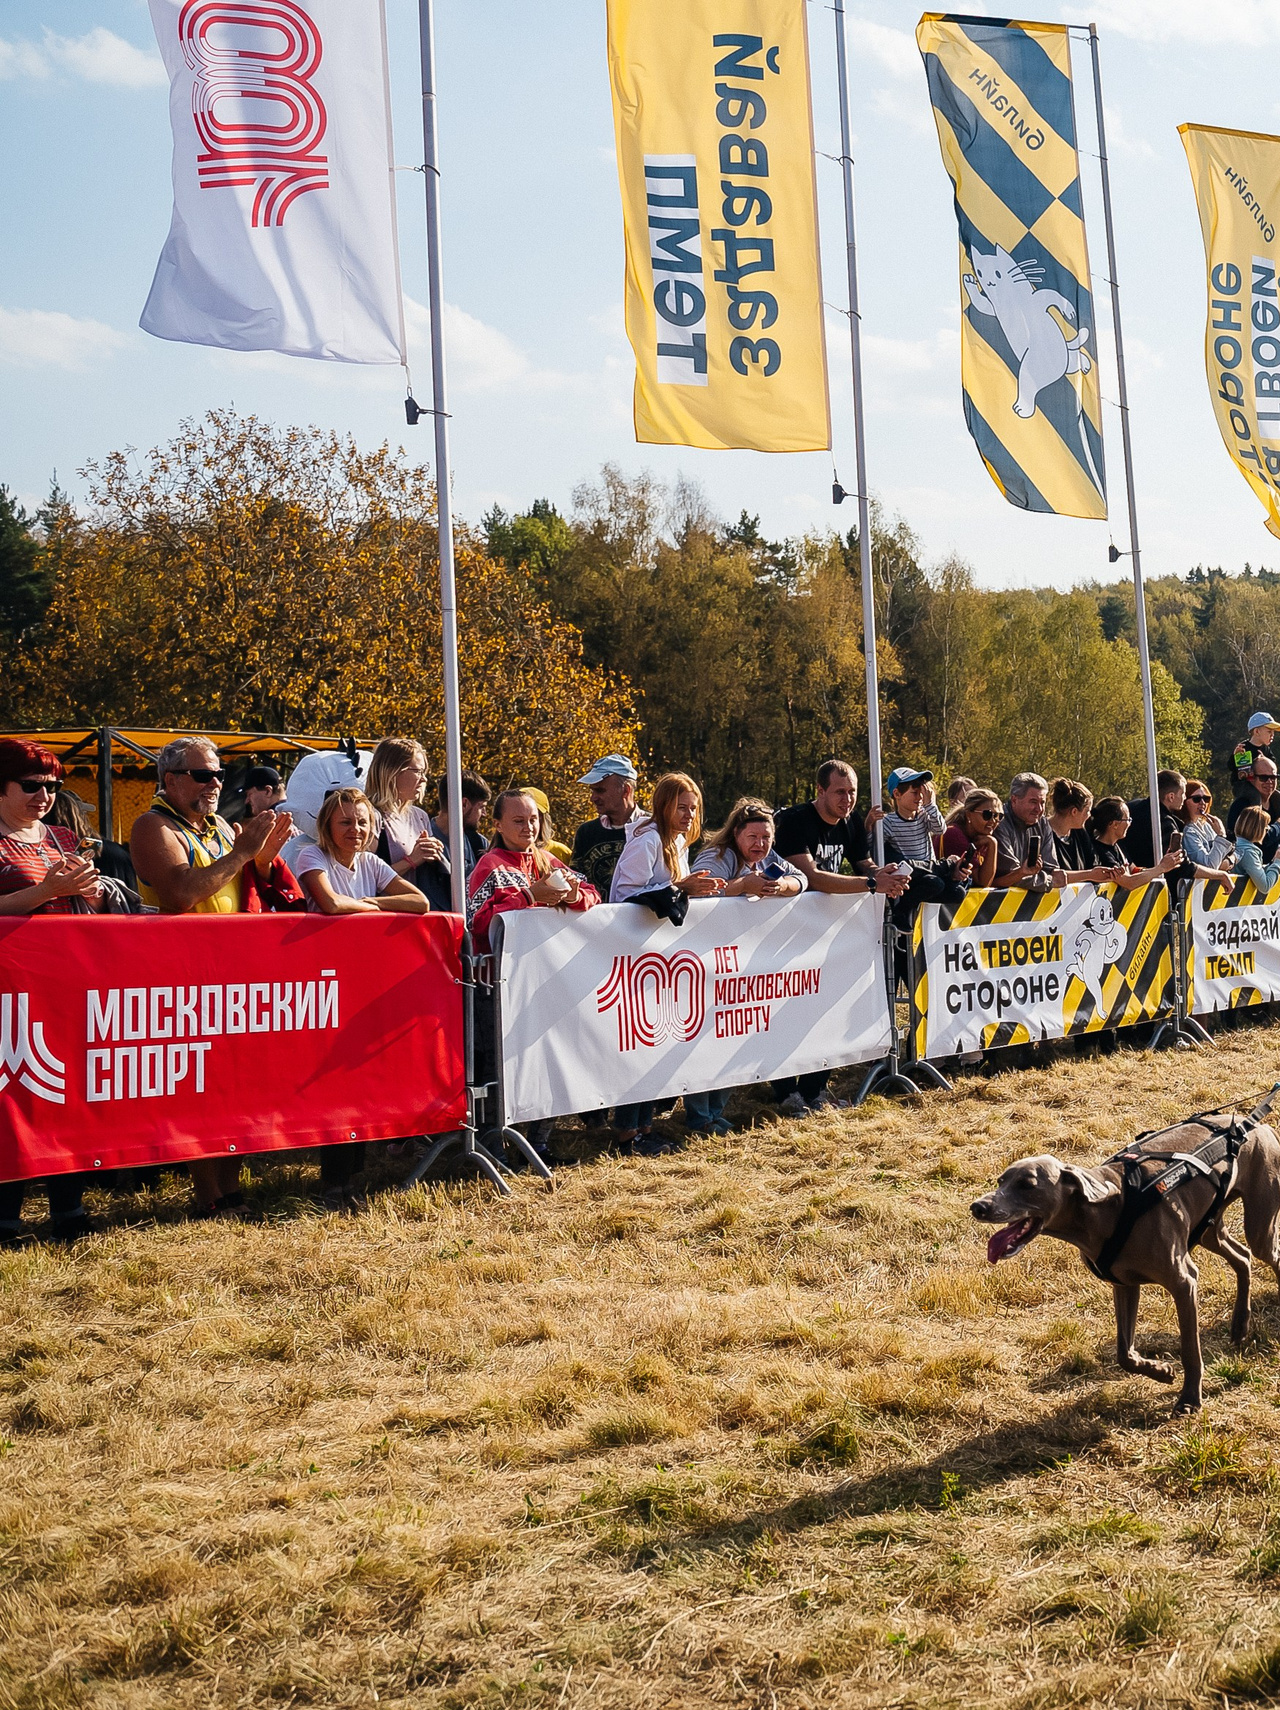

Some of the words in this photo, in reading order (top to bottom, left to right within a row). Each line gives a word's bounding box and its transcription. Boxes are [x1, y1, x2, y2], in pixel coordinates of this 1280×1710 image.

[944, 943, 978, 974] на
[980, 927, 1063, 969] твоей
[1206, 910, 1280, 949] задавай
[713, 945, 739, 975] ЛЕТ
[1127, 931, 1153, 982] билайн
[1207, 951, 1255, 980] темп
[87, 969, 339, 1043] МОСКОВСКИЙ
[597, 949, 706, 1052] 100
[713, 967, 821, 1008] МОСКОВСКОМУ
[945, 973, 1060, 1019] стороне
[714, 1004, 771, 1040] СПОРТУ
[86, 1041, 212, 1103] СПОРТ
